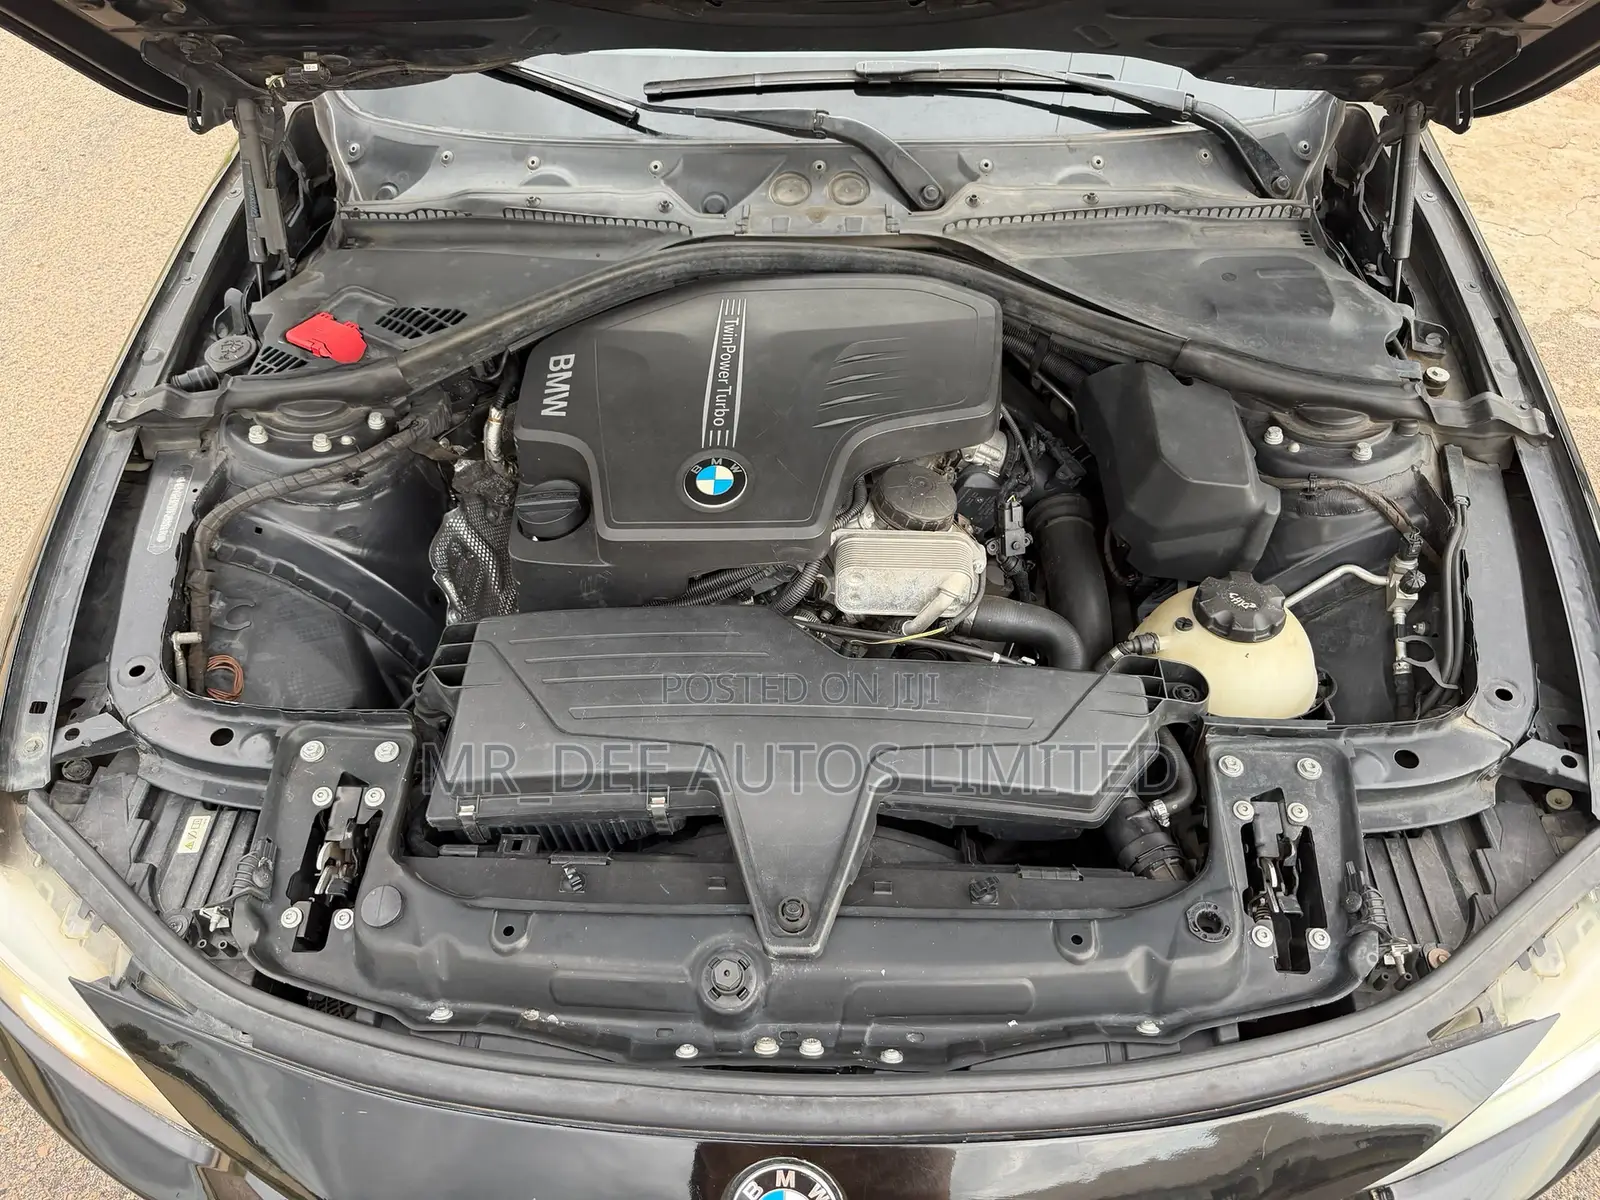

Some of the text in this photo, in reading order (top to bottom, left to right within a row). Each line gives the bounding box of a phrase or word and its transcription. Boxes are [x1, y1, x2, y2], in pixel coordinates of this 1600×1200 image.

[540, 353, 576, 417] BMW
[712, 317, 740, 427] TwinPower Turbo
[690, 457, 743, 475] BMW
[742, 1169, 832, 1200] BMW
